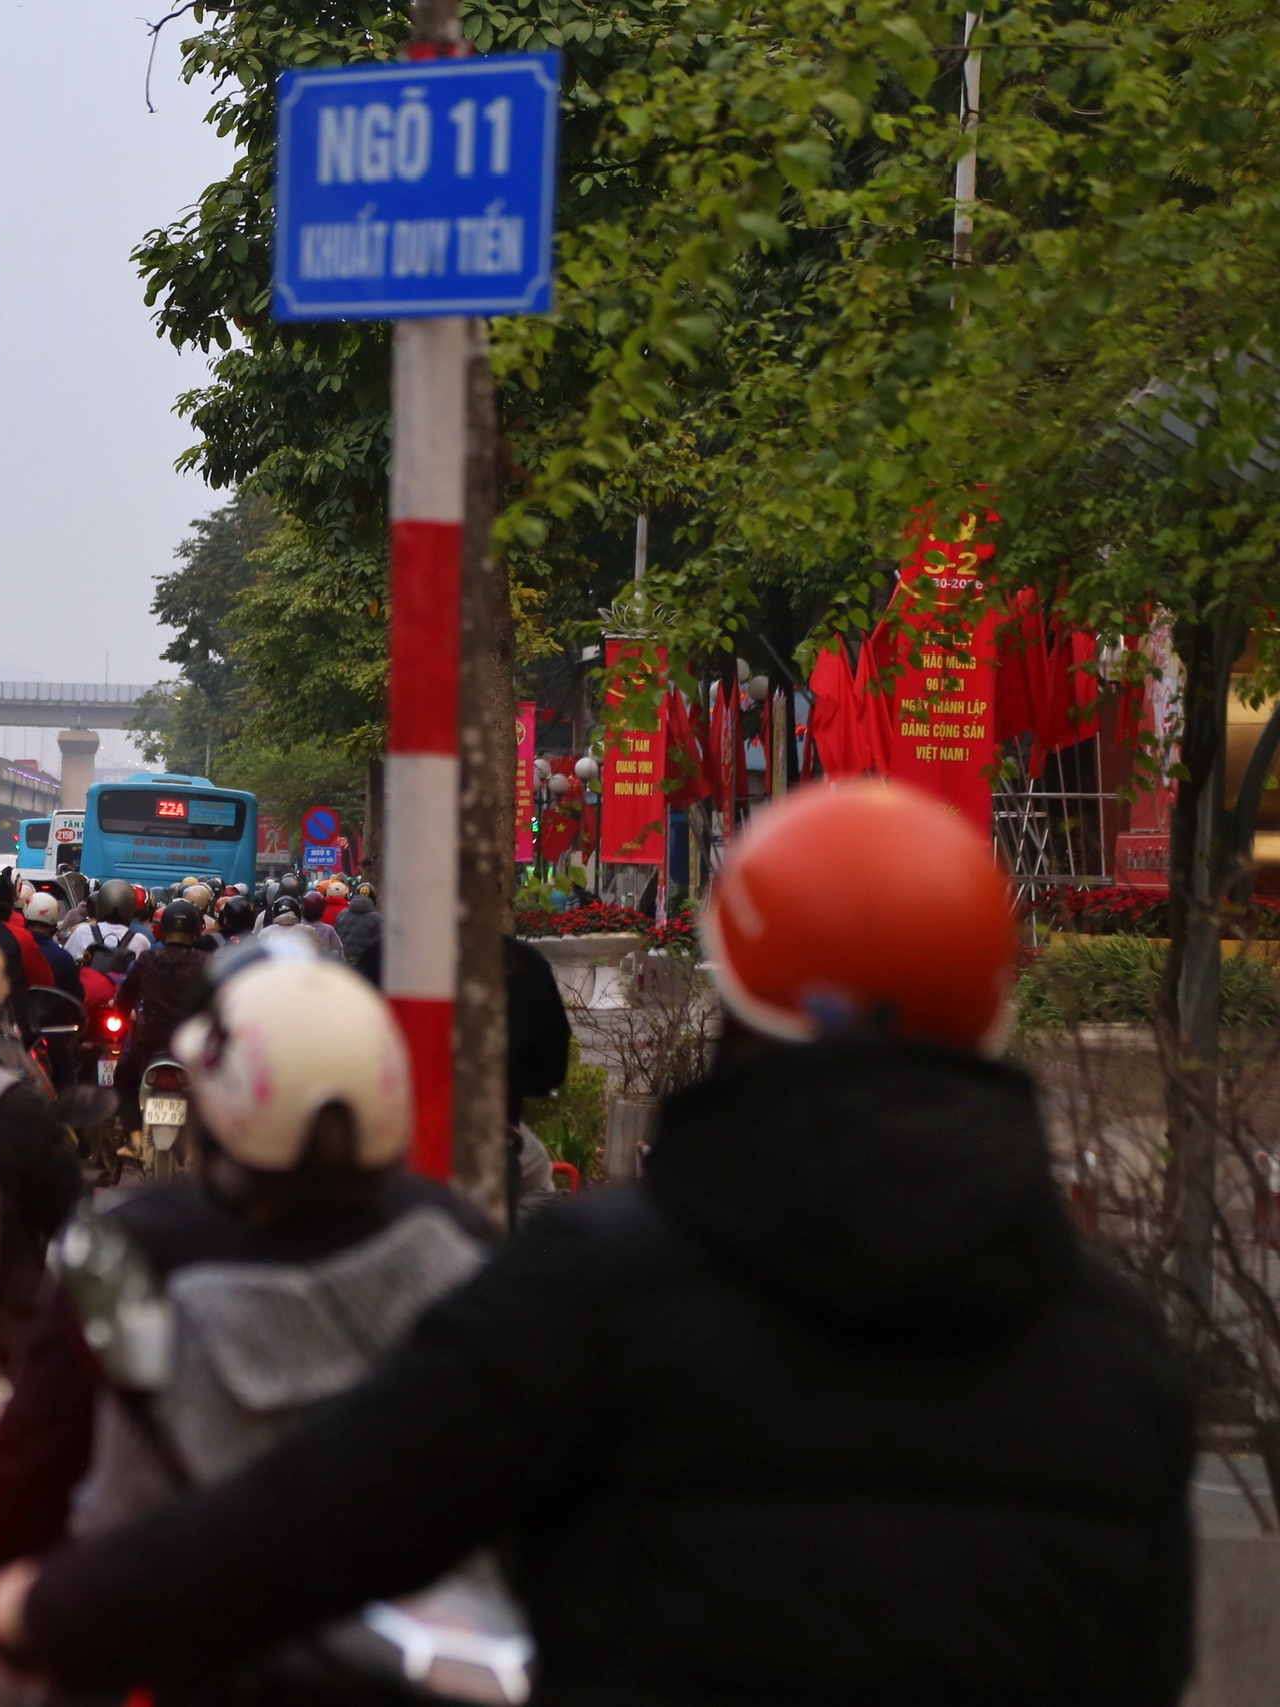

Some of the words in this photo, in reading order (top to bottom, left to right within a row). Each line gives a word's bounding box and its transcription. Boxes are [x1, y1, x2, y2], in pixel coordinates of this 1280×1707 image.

[316, 86, 432, 185] NGÕ
[449, 97, 512, 177] 11
[298, 200, 389, 281] KHUẤT
[391, 218, 452, 279] DUY
[456, 197, 524, 276] TIẾN
[926, 677, 938, 692] 96
[968, 698, 987, 719] LẬP
[933, 721, 960, 741] CỘNG
[963, 720, 985, 739] SẢN
[915, 744, 938, 763] VIỆT
[940, 747, 964, 761] NAM
[158, 801, 185, 817] 22A
[57, 831, 74, 840] 215B
